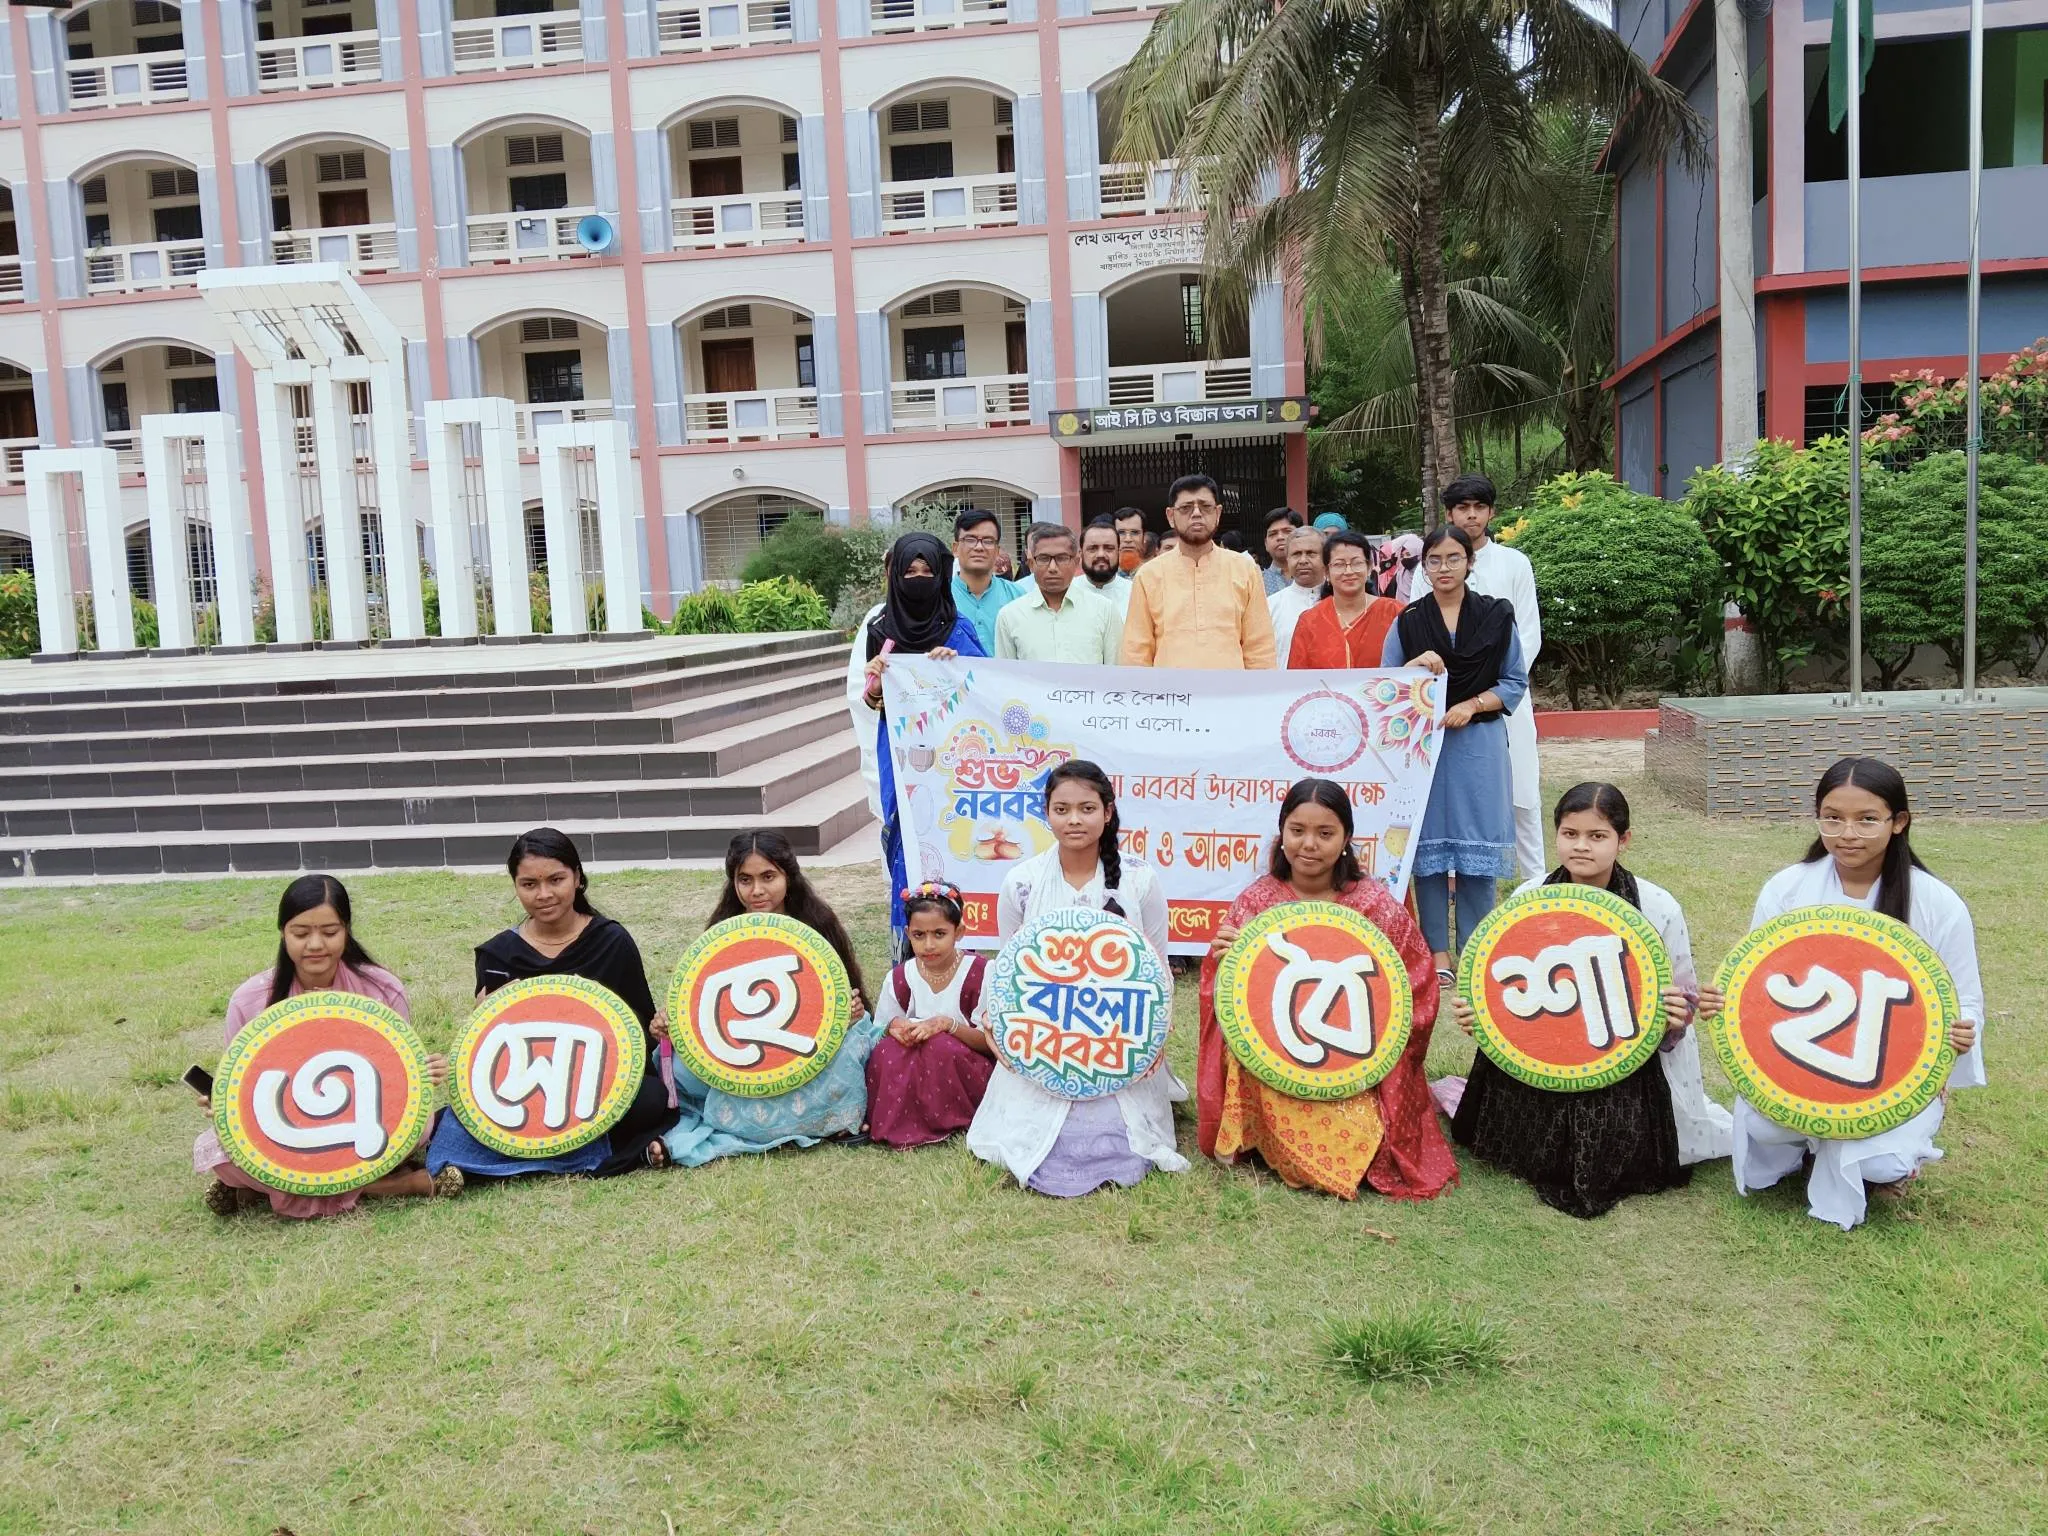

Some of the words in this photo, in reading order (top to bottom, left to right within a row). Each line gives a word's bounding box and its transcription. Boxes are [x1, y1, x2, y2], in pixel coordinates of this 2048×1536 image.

[1074, 233, 1099, 246] শেখ
[1149, 226, 1184, 241] ওহাব
[1160, 411, 1172, 423] ও
[1175, 406, 1219, 424] বিজ্ঞান
[1222, 405, 1259, 420] ভবন
[1047, 690, 1094, 704] এসো
[1102, 690, 1127, 707] হে
[1131, 690, 1193, 707] বৈশাখ
[1082, 716, 1129, 731] এসো
[954, 752, 1045, 790] শুভ
[1131, 768, 1201, 801] নববর্ষ
[1156, 830, 1175, 868] ও
[1182, 828, 1263, 873] আনন্দ
[1023, 928, 1131, 984] শুভ
[697, 953, 817, 1067] হে
[1025, 981, 1152, 1036] বাংলা
[1266, 932, 1375, 1066] বৈ
[1491, 935, 1634, 1050] শা
[1008, 1018, 1135, 1070] নববর্ষ
[1766, 966, 1911, 1088] খ
[471, 1020, 607, 1130] সো
[252, 1050, 388, 1160] এ
